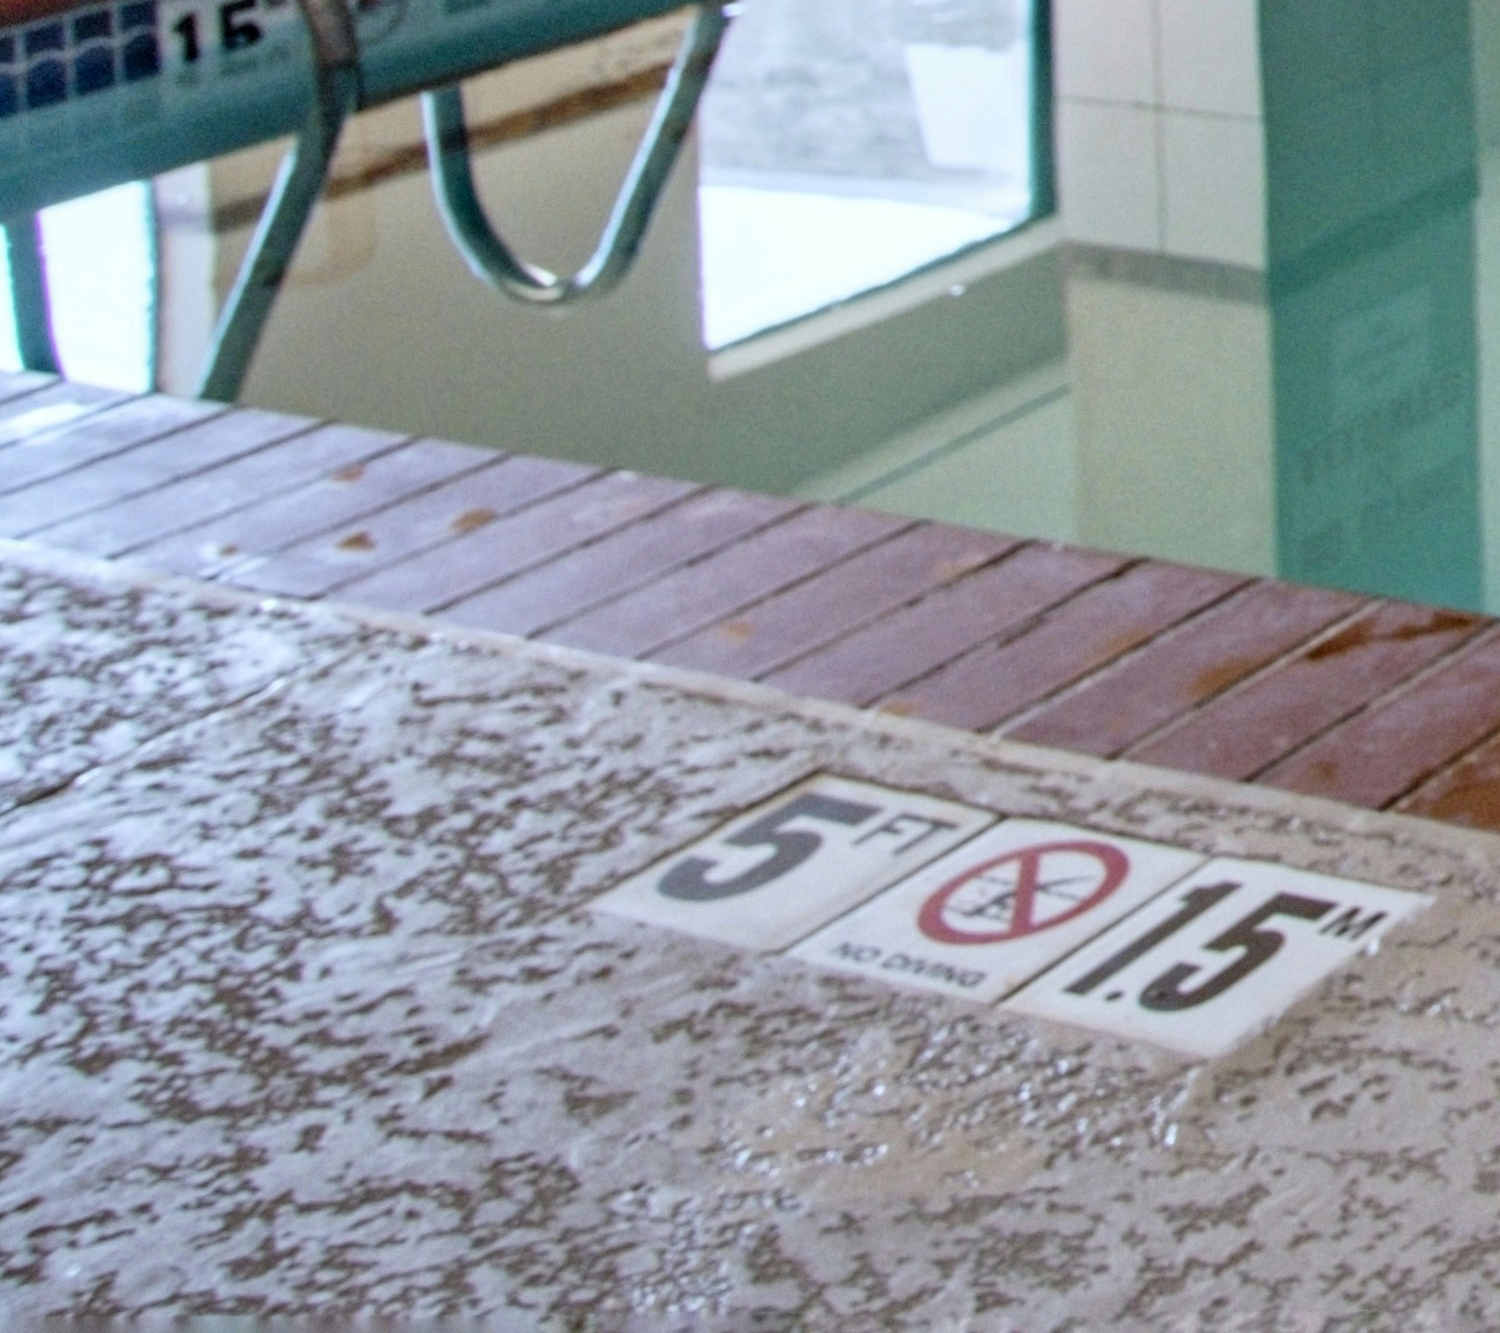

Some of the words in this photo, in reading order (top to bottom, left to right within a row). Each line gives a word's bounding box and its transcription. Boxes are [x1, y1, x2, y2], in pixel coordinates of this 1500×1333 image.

[656, 792, 885, 902] 5
[851, 813, 961, 859] FT
[1318, 904, 1388, 942] M
[830, 941, 881, 964] NO
[881, 952, 987, 989] DIVING
